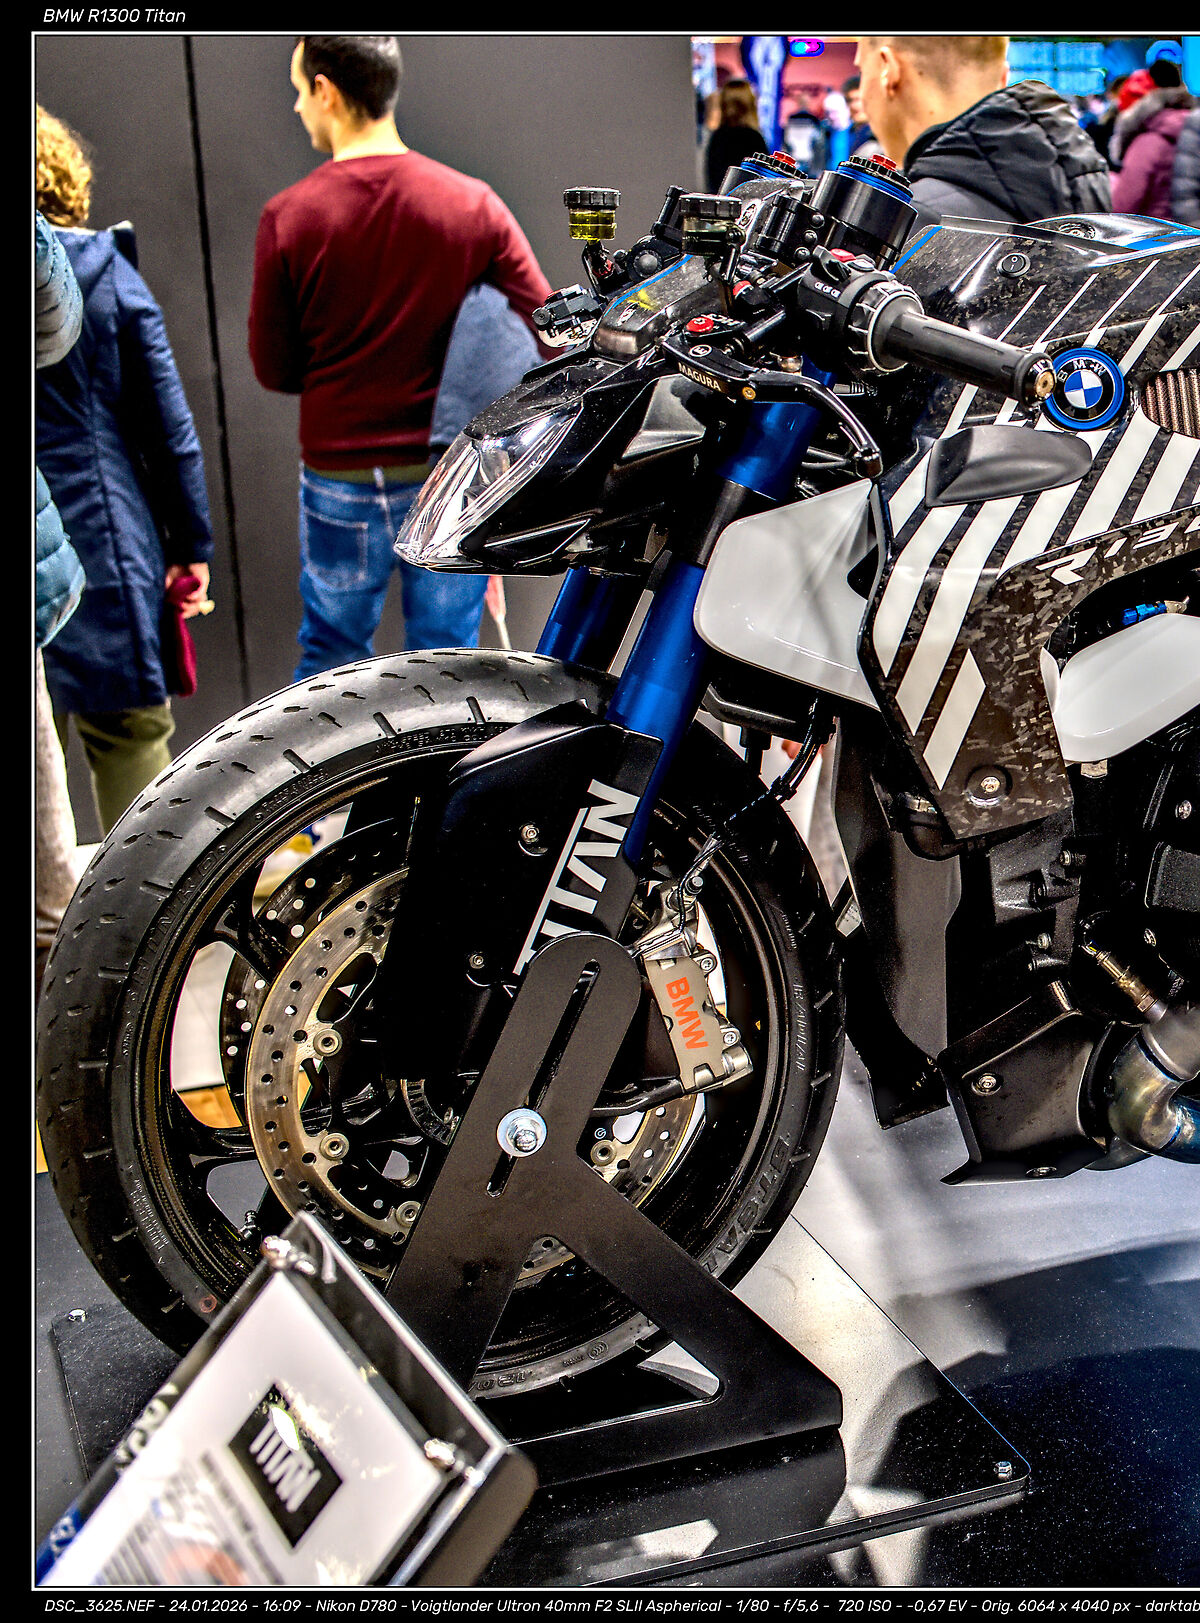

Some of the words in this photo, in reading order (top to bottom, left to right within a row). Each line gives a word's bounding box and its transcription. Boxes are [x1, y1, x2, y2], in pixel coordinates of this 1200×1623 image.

[677, 361, 722, 393] MAGURA
[1057, 358, 1107, 383] BMW
[665, 976, 709, 1051] BMW
